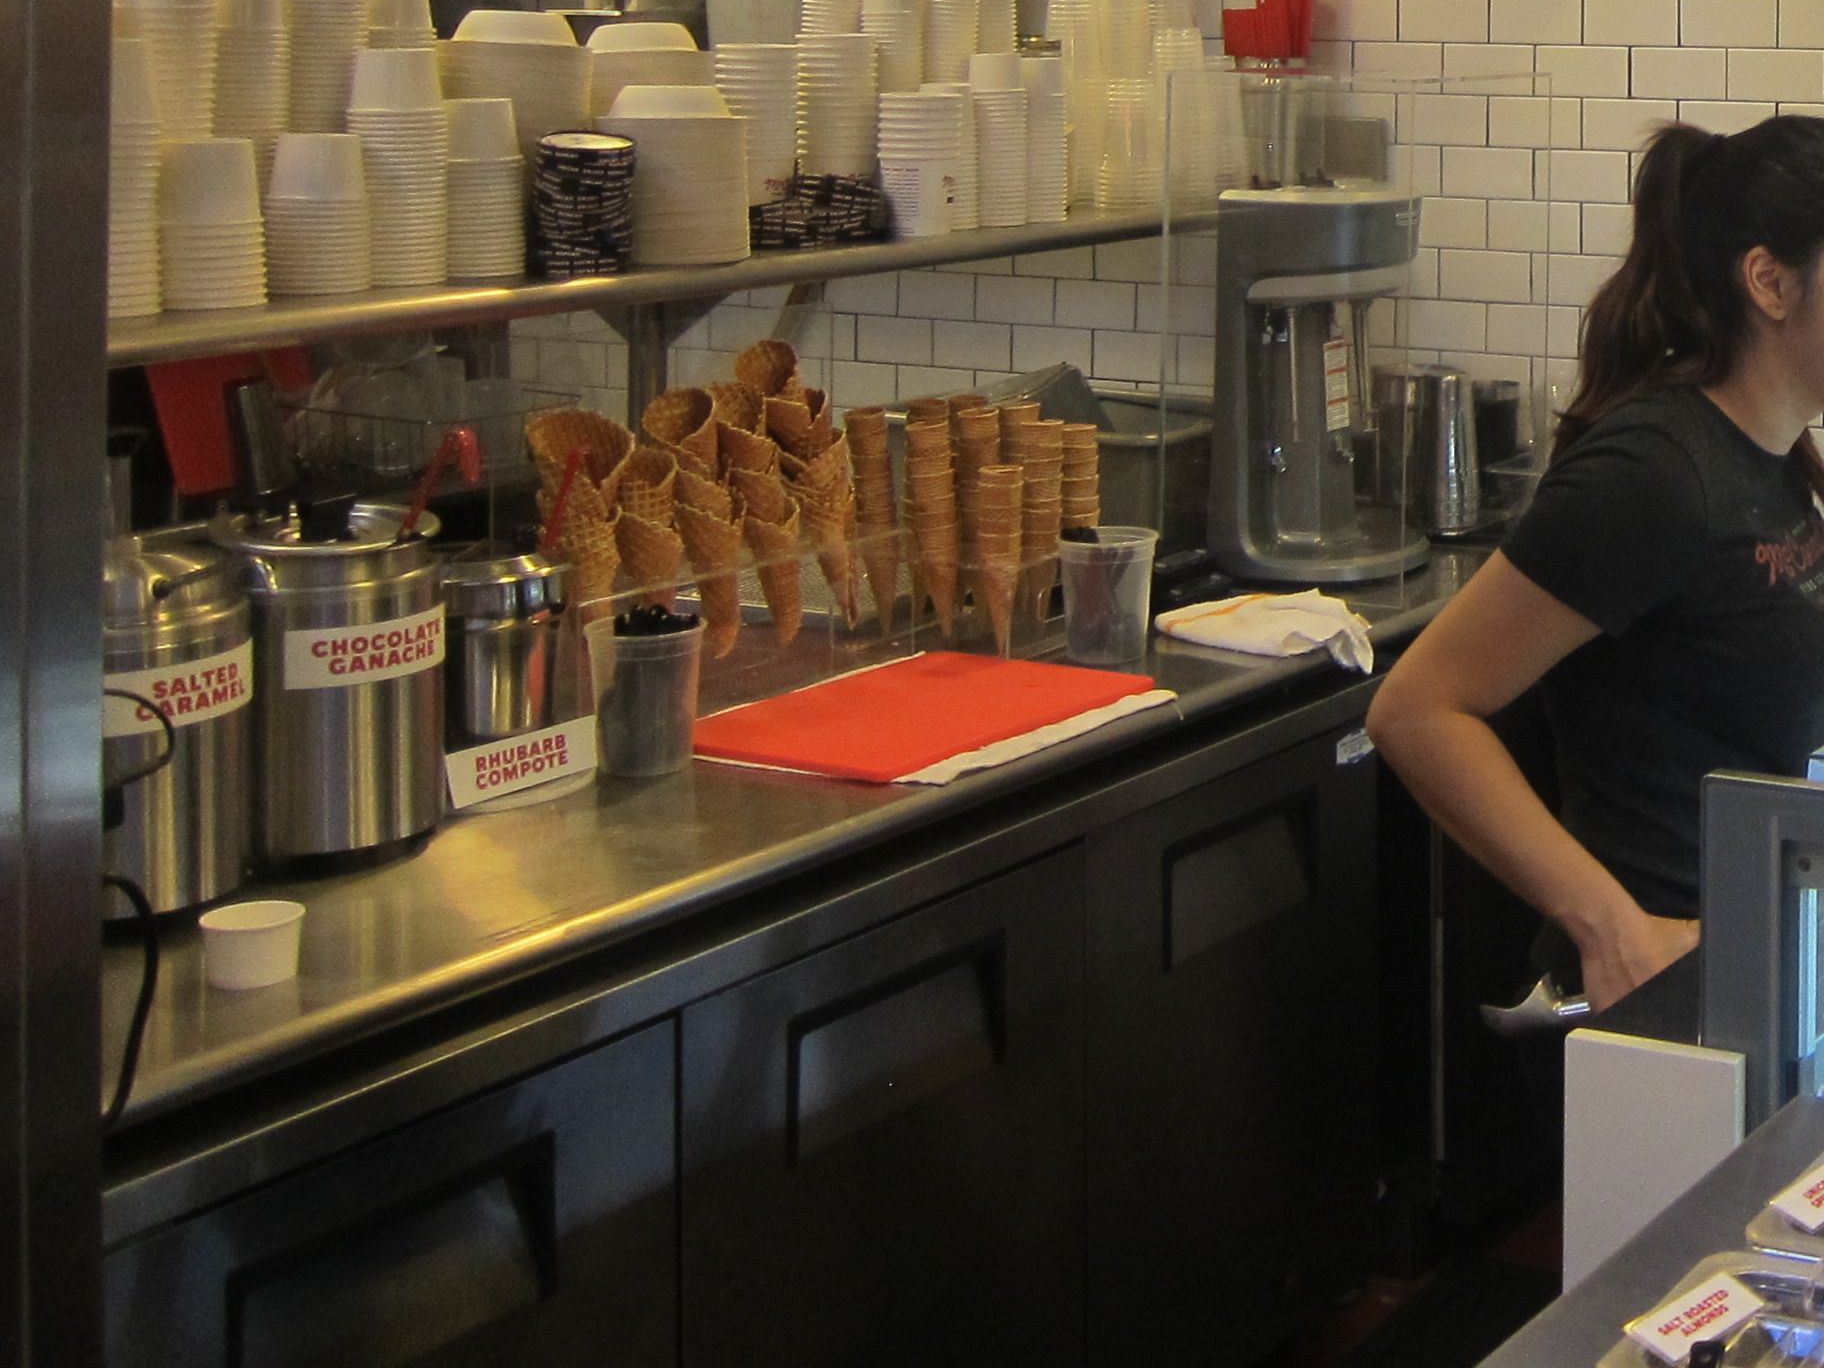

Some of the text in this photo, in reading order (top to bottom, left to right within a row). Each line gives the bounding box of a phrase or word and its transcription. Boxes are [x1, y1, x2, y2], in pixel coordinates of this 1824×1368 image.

[310, 616, 443, 659] CHOCOLATE
[327, 639, 436, 675] GANACHE
[151, 661, 240, 700] SALTED
[134, 680, 246, 723] CARAMEL
[475, 734, 567, 773] RHUBARB
[475, 750, 569, 791] COMPOTE
[1657, 1289, 1730, 1336] SALT ROASTED
[1680, 1304, 1730, 1337] ALMONDS
